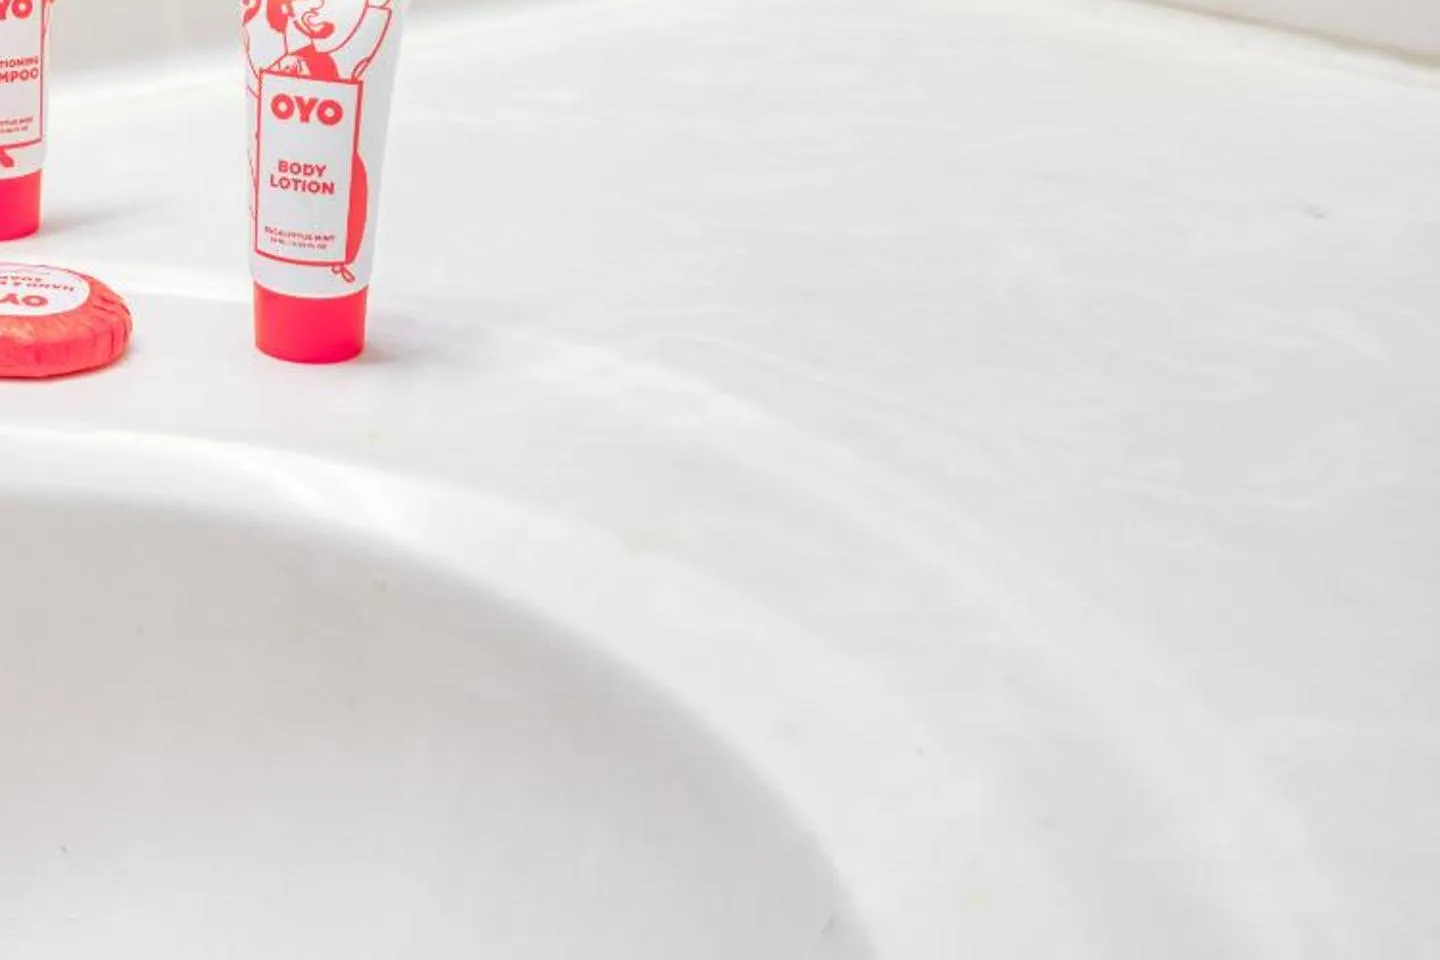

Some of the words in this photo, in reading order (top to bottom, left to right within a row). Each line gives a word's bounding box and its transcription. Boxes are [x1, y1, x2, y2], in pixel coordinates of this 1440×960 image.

[271, 93, 343, 126] OYO
[278, 159, 327, 177] BODY
[270, 174, 335, 194] LOTION
